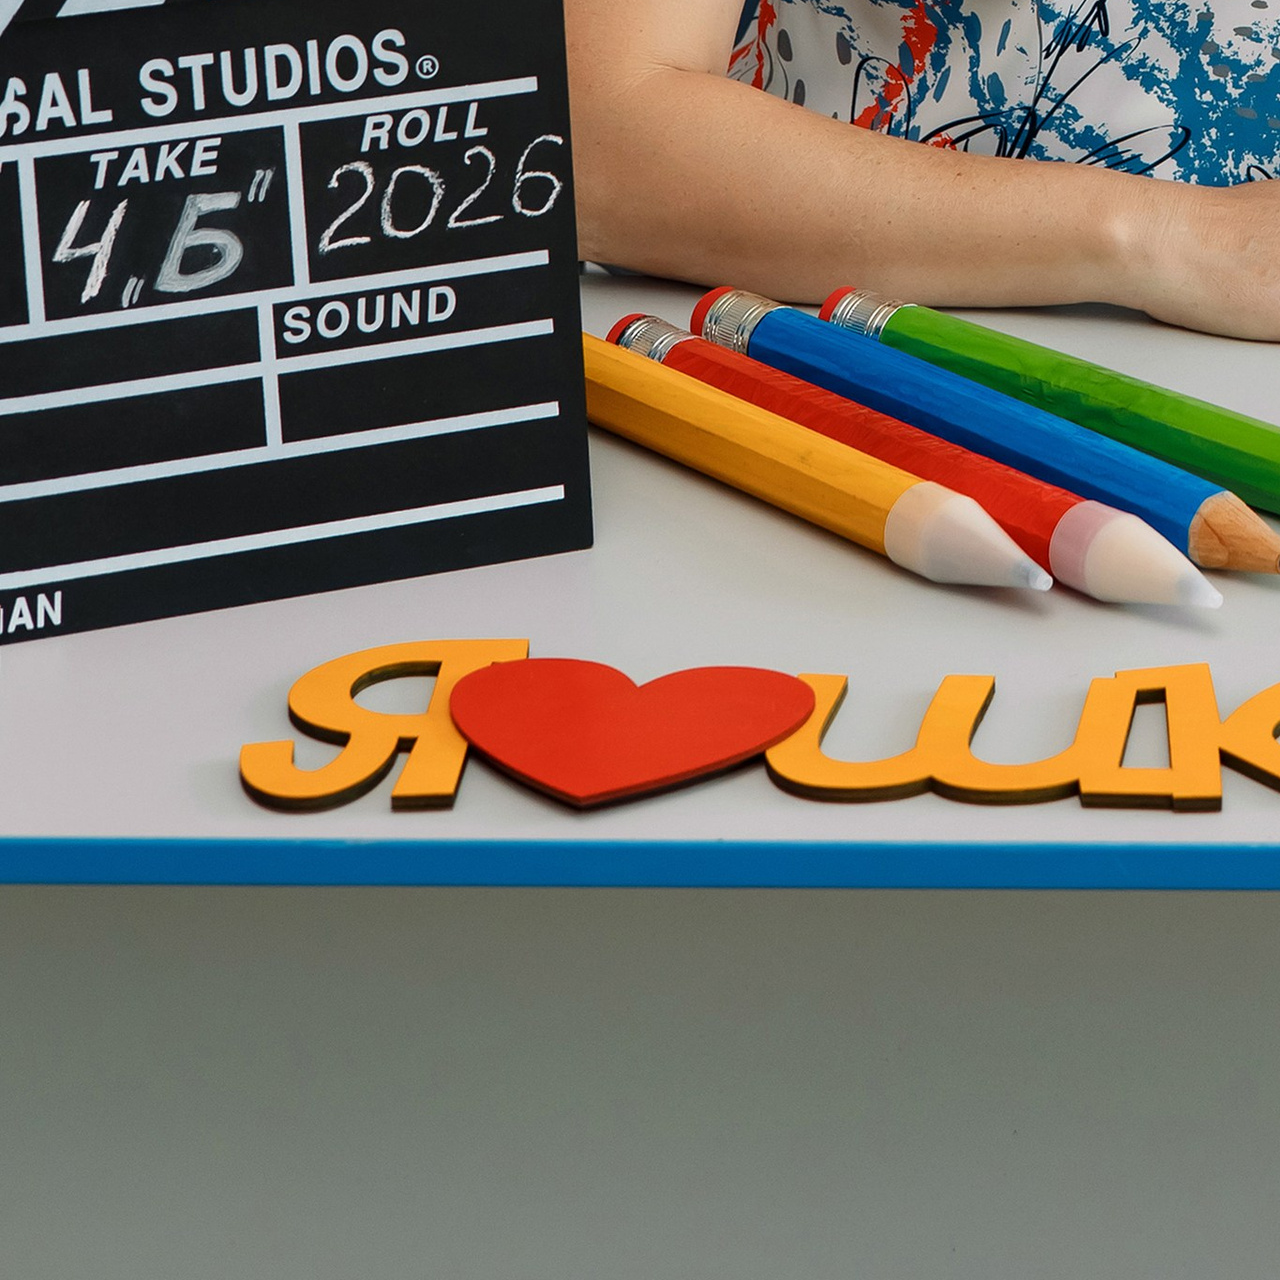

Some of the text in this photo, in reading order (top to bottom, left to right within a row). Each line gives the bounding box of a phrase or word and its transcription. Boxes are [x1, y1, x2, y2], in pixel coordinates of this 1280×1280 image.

[0, 68, 113, 137] SAL
[361, 102, 488, 152] ROLL
[90, 137, 221, 189] TAKE
[319, 134, 563, 255] 2026
[282, 285, 457, 344] SOUND
[0, 590, 63, 635] AN
[238, 638, 531, 813] Я
